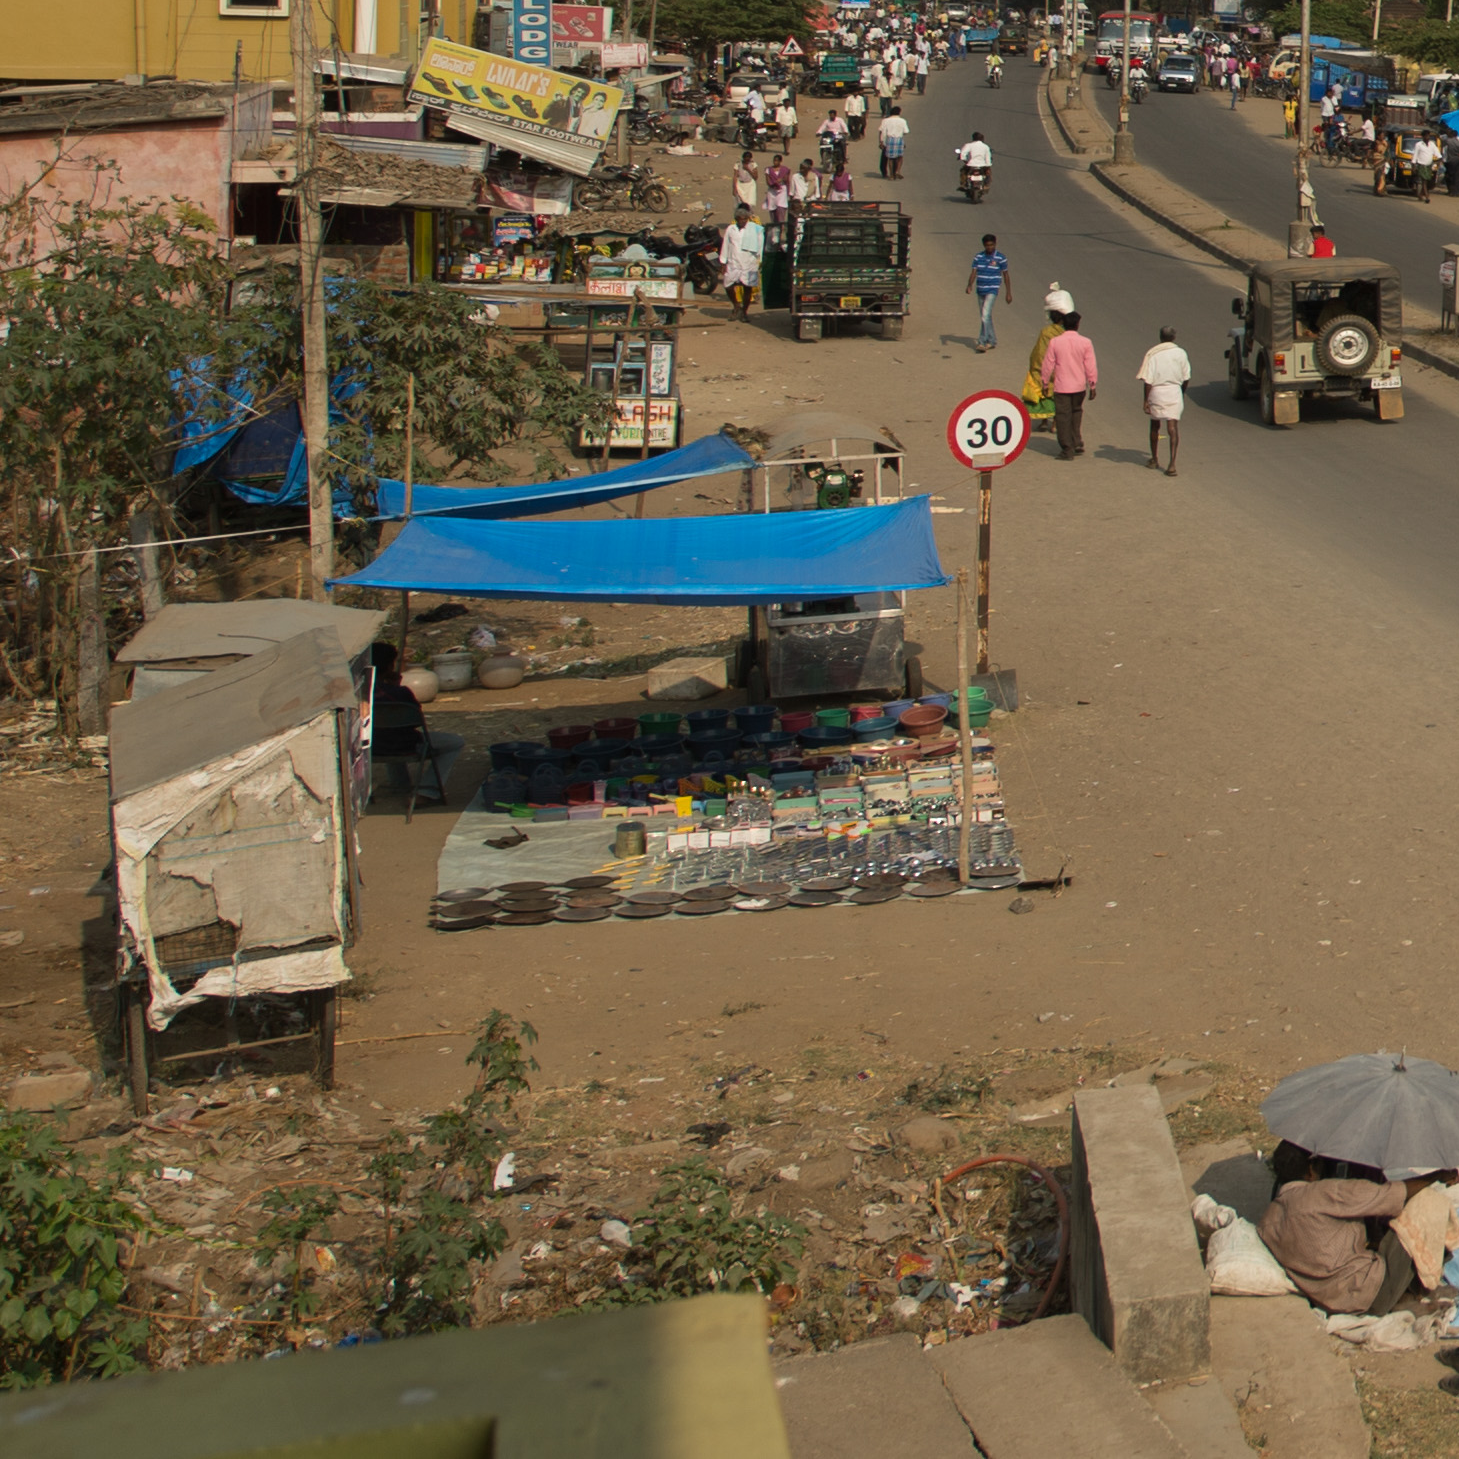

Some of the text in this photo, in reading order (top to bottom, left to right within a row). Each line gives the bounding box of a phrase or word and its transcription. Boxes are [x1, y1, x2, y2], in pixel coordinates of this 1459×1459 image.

[513, 118, 604, 150] STAR FOOTWEAR
[612, 405, 672, 423] ILASH
[967, 415, 1013, 448] 30
